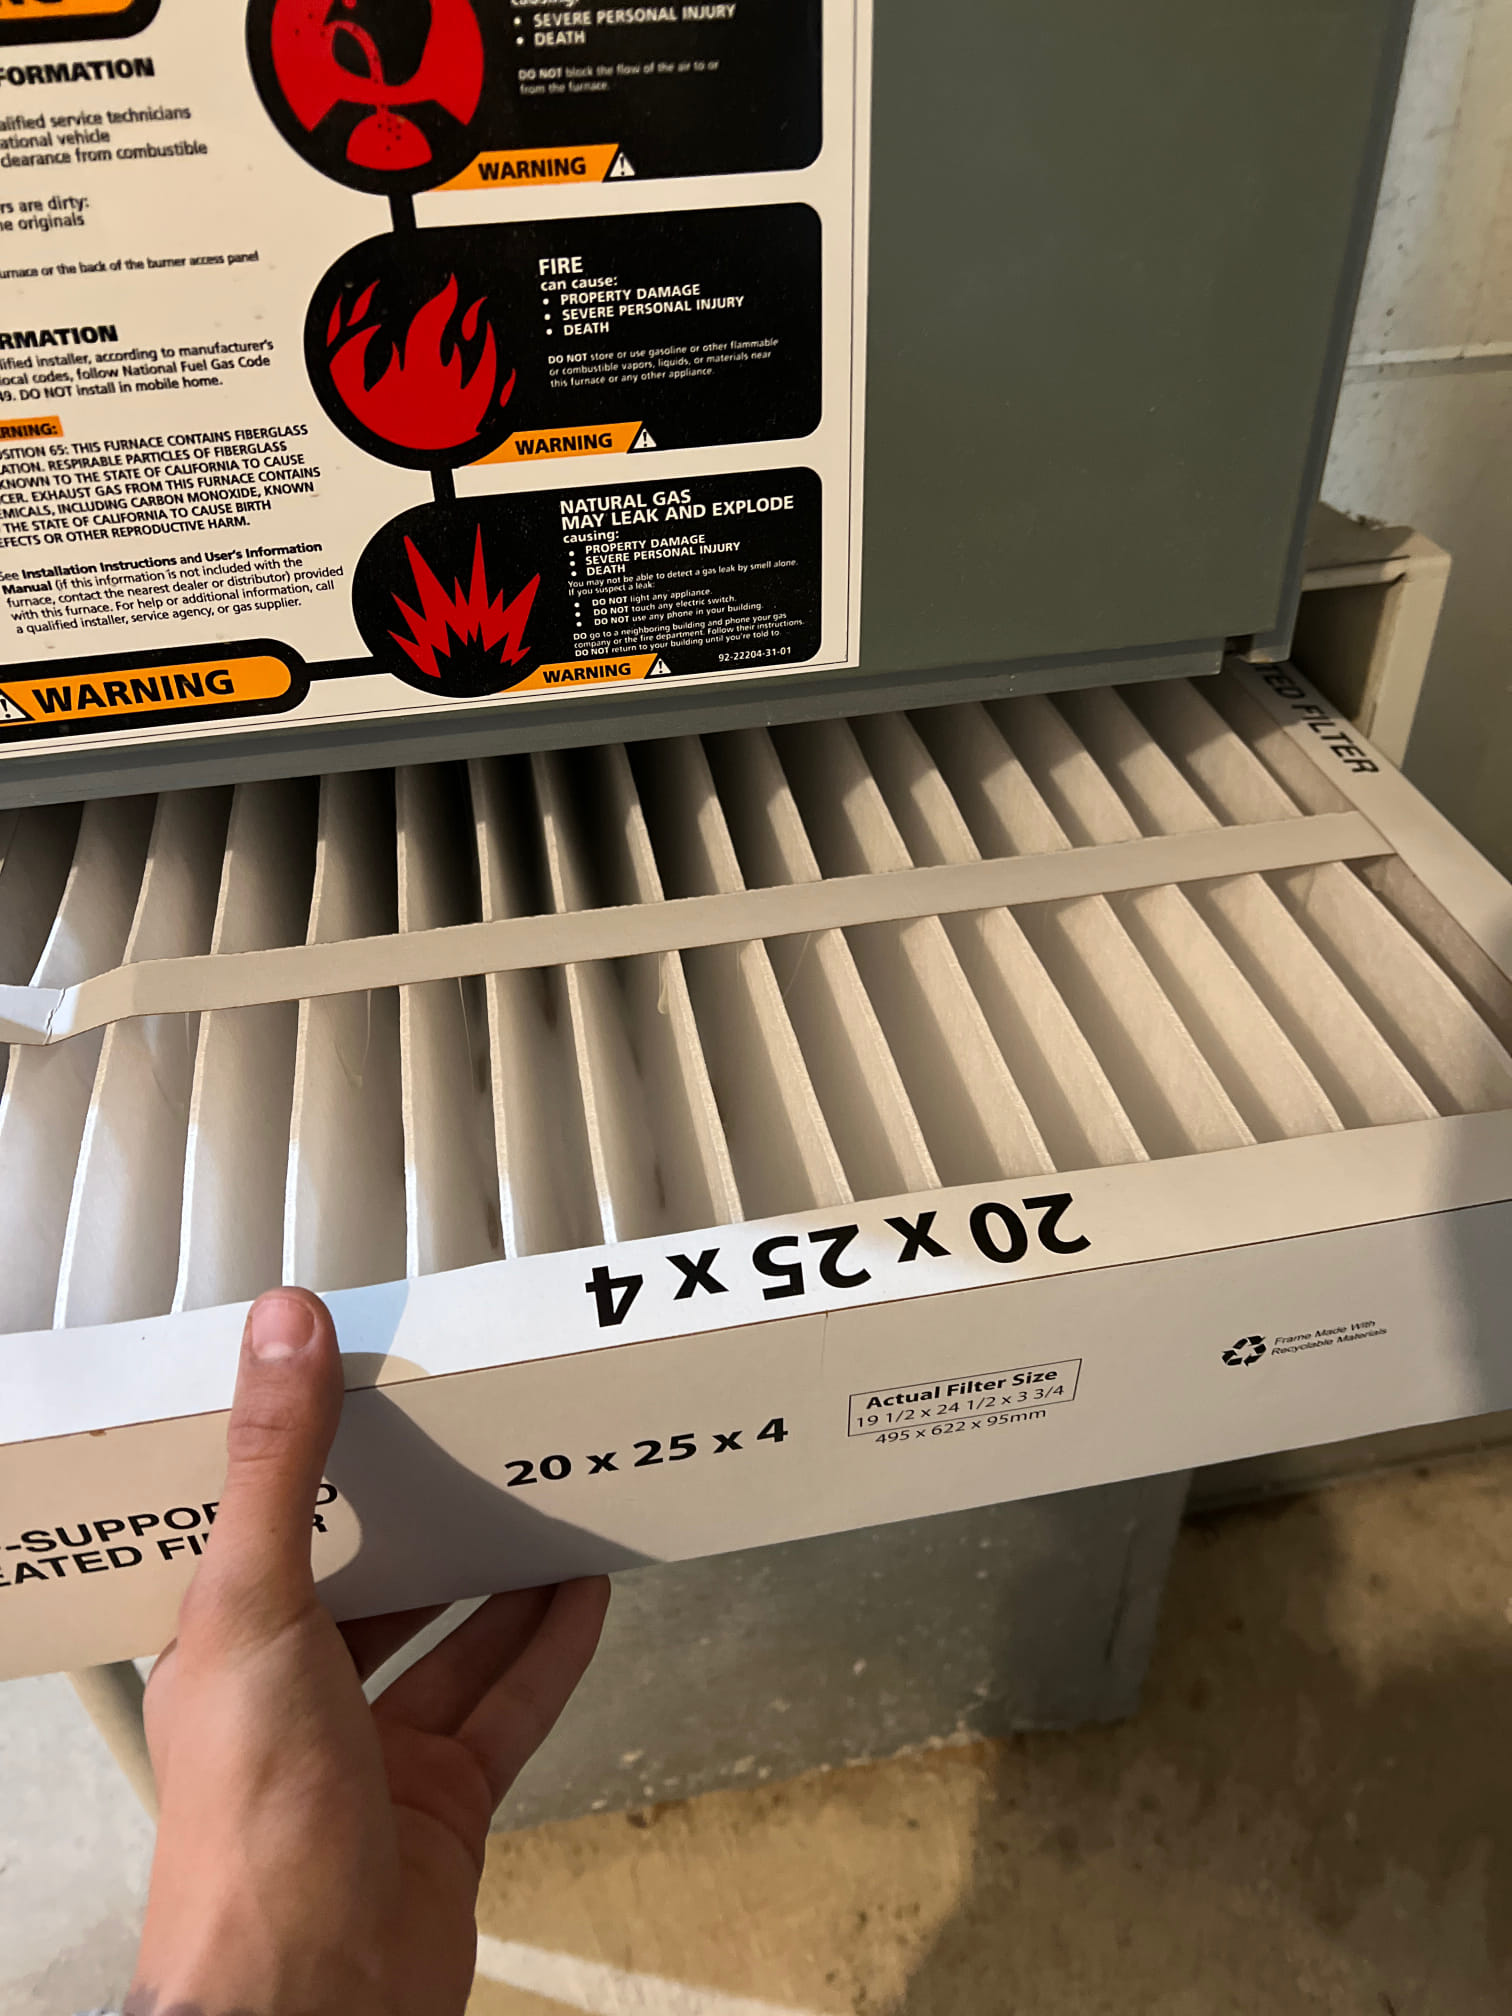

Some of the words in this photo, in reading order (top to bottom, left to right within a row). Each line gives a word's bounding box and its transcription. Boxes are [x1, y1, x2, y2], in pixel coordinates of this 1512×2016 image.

[533, 11, 591, 27] SEVERE
[596, 7, 677, 23] PERSONAL
[682, 4, 735, 19] INJURY
[534, 30, 585, 45] DEATH
[50, 111, 103, 127] service
[106, 106, 192, 124] technicians
[478, 157, 586, 181] WARNING
[538, 256, 583, 275] FIRE
[540, 280, 566, 291] can
[571, 276, 617, 288] cause:
[560, 289, 630, 304] PROPERTY
[637, 283, 699, 299] DAMAGE
[562, 305, 614, 320] SEVERE
[619, 300, 691, 315] PERSONAL
[696, 296, 744, 309] INJURY
[563, 321, 609, 335] DEATH
[548, 354, 563, 364] DO
[566, 352, 587, 362] NOT
[590, 352, 613, 360] store
[629, 349, 645, 357] use
[648, 346, 687, 358] gasoline
[702, 342, 727, 351] other
[730, 338, 778, 348] flammable
[0, 423, 58, 438] RNING:
[48, 444, 69, 455] 65:
[70, 441, 101, 453] THIS
[103, 436, 164, 450] FURNACE
[166, 430, 231, 446] CONTAINS
[234, 424, 308, 440] FIBERGLASS
[514, 432, 612, 456] WARNING
[31, 487, 90, 501] EXHAUST
[95, 484, 122, 496] GAS
[125, 481, 162, 493] FROM
[165, 478, 193, 490] THIS
[197, 472, 255, 487] FURNACE
[258, 466, 320, 481] CONTAINS
[53, 474, 71, 485] TO
[74, 471, 100, 483] THE
[103, 468, 140, 481] STATE
[144, 466, 160, 477] OF
[164, 460, 239, 475] CALIFORNIA
[241, 457, 260, 468] TO
[263, 453, 304, 467] CAUSE
[57, 498, 127, 513] INCLUDING
[130, 493, 183, 507] CARBON
[187, 486, 260, 502] MONOXIDE,
[264, 481, 313, 495] KNOWN
[560, 494, 647, 513] NATURAL
[653, 489, 690, 505] GAS
[562, 513, 603, 530] MAY
[611, 508, 658, 525] LEAK
[665, 504, 705, 520] AND
[712, 495, 793, 515] EXPLODE
[3, 521, 28, 532] THE
[31, 517, 69, 530] STATE
[72, 515, 88, 527] OF
[93, 509, 168, 525] CALIFORNIA
[170, 507, 187, 518] TO
[191, 503, 232, 516] CAUSE
[235, 499, 271, 512] BIRTH
[562, 530, 619, 543] causing:
[585, 540, 645, 553] PROPERTY
[650, 534, 704, 547] DAMAGE
[21, 564, 97, 578] Installation
[99, 557, 177, 571] Instructions
[179, 552, 202, 564] and
[204, 549, 242, 561] User's
[245, 542, 322, 557] Information
[585, 552, 630, 565] SEVERE
[633, 546, 696, 560] PERSONAL
[699, 541, 740, 553] INJURY
[1, 580, 53, 594] Manual
[55, 578, 67, 591] (if
[70, 577, 93, 588] this
[94, 571, 165, 586] information
[165, 568, 177, 579] is
[179, 567, 200, 578] not
[201, 561, 251, 575] included
[253, 558, 280, 570] with
[282, 557, 303, 567] the
[586, 563, 625, 575] DEATH
[6, 596, 55, 607] furnace,
[58, 590, 101, 603] contact
[104, 587, 123, 598] the
[127, 584, 169, 596] nearest
[172, 579, 207, 591] dealer
[211, 579, 223, 588] or
[227, 571, 290, 586] distributor)
[293, 565, 343, 582] provided
[10, 609, 38, 620] with
[40, 606, 63, 618] this
[65, 604, 113, 615] furnace.
[115, 600, 134, 610] For
[136, 597, 163, 609] help
[166, 597, 178, 605] or
[182, 589, 239, 604] additional
[241, 583, 312, 597] information,
[315, 579, 334, 591] call
[26, 618, 78, 634] qualified
[80, 614, 128, 627] installer,
[130, 610, 169, 622] service
[172, 607, 214, 620] agency,
[217, 605, 229, 613] or
[232, 603, 252, 614] gas
[254, 597, 301, 610] supplier.
[718, 646, 790, 661] 92-22204-31-01
[542, 663, 631, 684] WARNING
[32, 669, 234, 714] WARNING
[1291, 704, 1379, 772] FILTER
[884, 1210, 951, 1263] x
[969, 1192, 1091, 1264] 20
[666, 1248, 729, 1300] x
[752, 1224, 872, 1300] 25
[585, 1266, 643, 1328] 4
[1272, 1340, 1334, 1355] Recyclable
[1336, 1328, 1387, 1343] Materials
[1274, 1334, 1312, 1345] Frame
[1314, 1326, 1347, 1338] Made
[1351, 1320, 1376, 1331] With
[866, 1386, 940, 1409] Actual
[947, 1378, 1006, 1396] Filter
[1012, 1370, 1058, 1386] Size
[856, 1416, 878, 1428] 19
[887, 1409, 915, 1423] 1/2
[920, 1408, 932, 1417] x
[936, 1402, 960, 1416] 24
[968, 1396, 996, 1410] 1/2
[1002, 1396, 1012, 1404] x
[1017, 1391, 1028, 1402] 3
[1033, 1385, 1064, 1399] 3/4
[875, 1430, 910, 1444] 495
[916, 1429, 926, 1438] x
[932, 1421, 966, 1436] 622
[971, 1420, 982, 1430] x
[987, 1410, 1046, 1426] 95mm
[504, 1455, 572, 1487] 20
[586, 1452, 619, 1474] x
[633, 1433, 696, 1467] 25
[712, 1430, 743, 1454] x
[756, 1418, 788, 1442] 4
